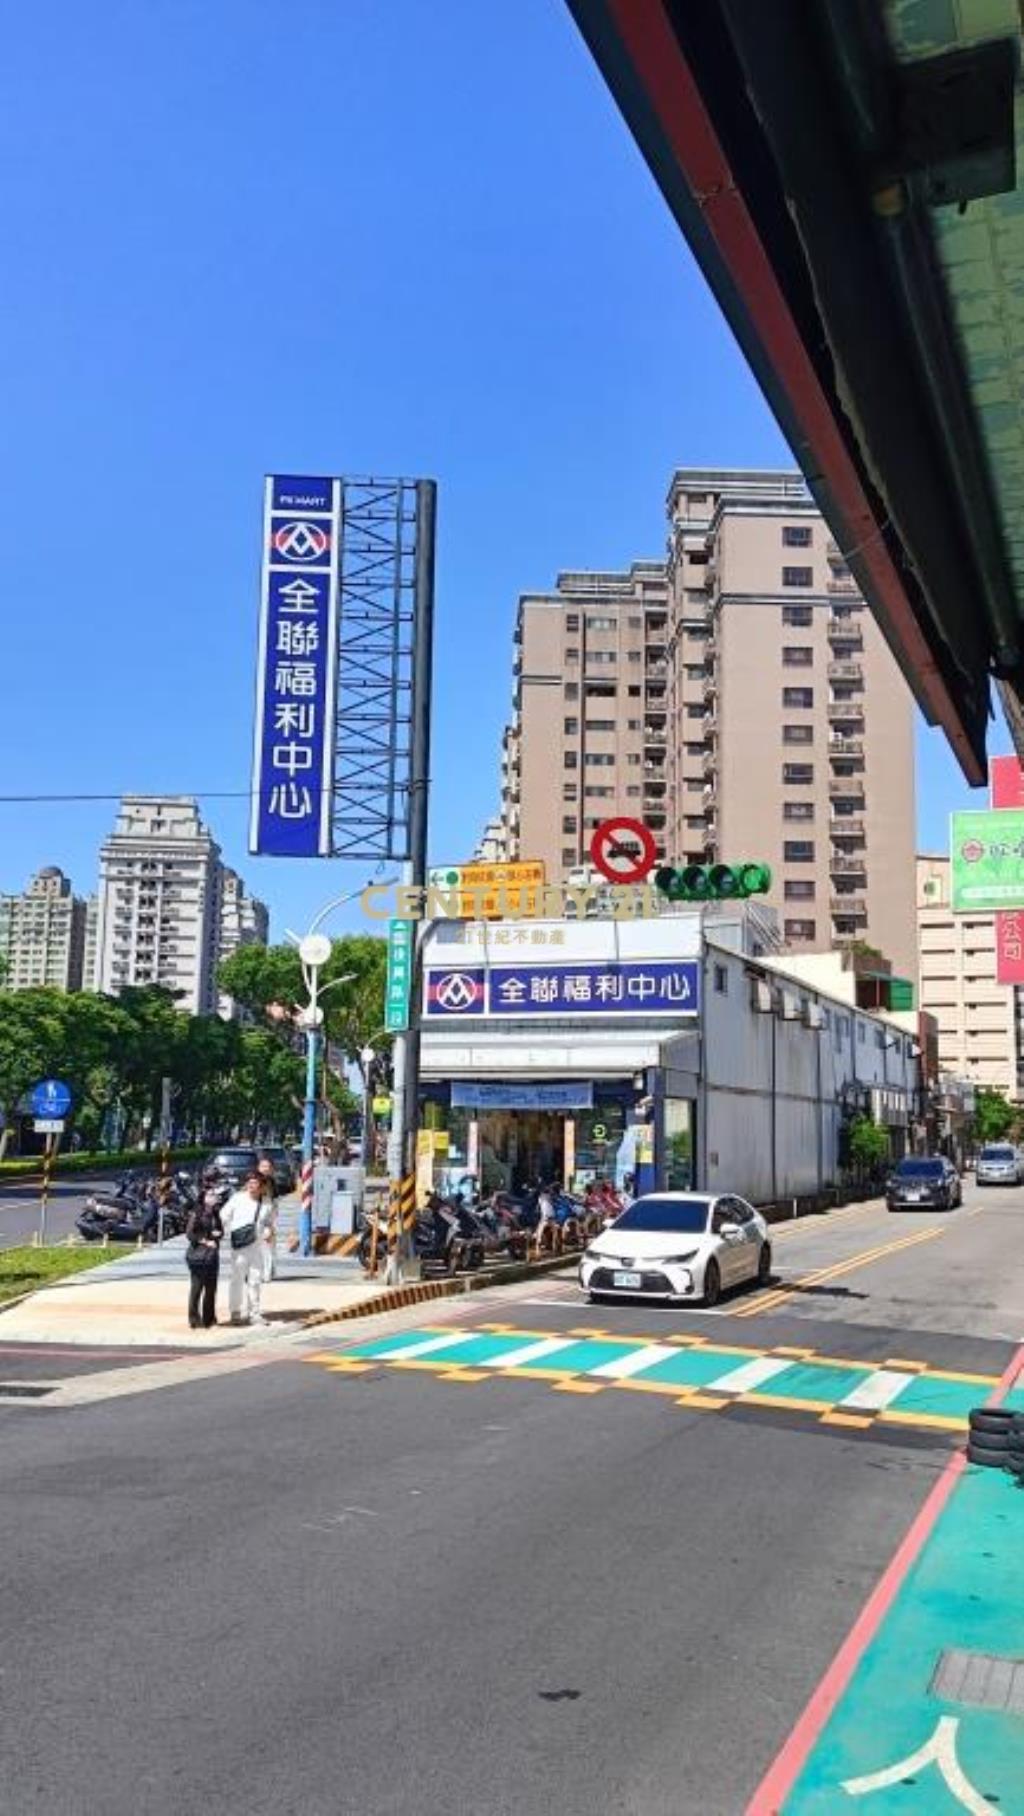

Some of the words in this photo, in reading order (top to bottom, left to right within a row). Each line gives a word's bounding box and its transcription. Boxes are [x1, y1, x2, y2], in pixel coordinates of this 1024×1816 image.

[295, 496, 327, 507] MART
[268, 577, 321, 818] 全聯福利中心
[497, 973, 691, 1004] 全聯福利中心
